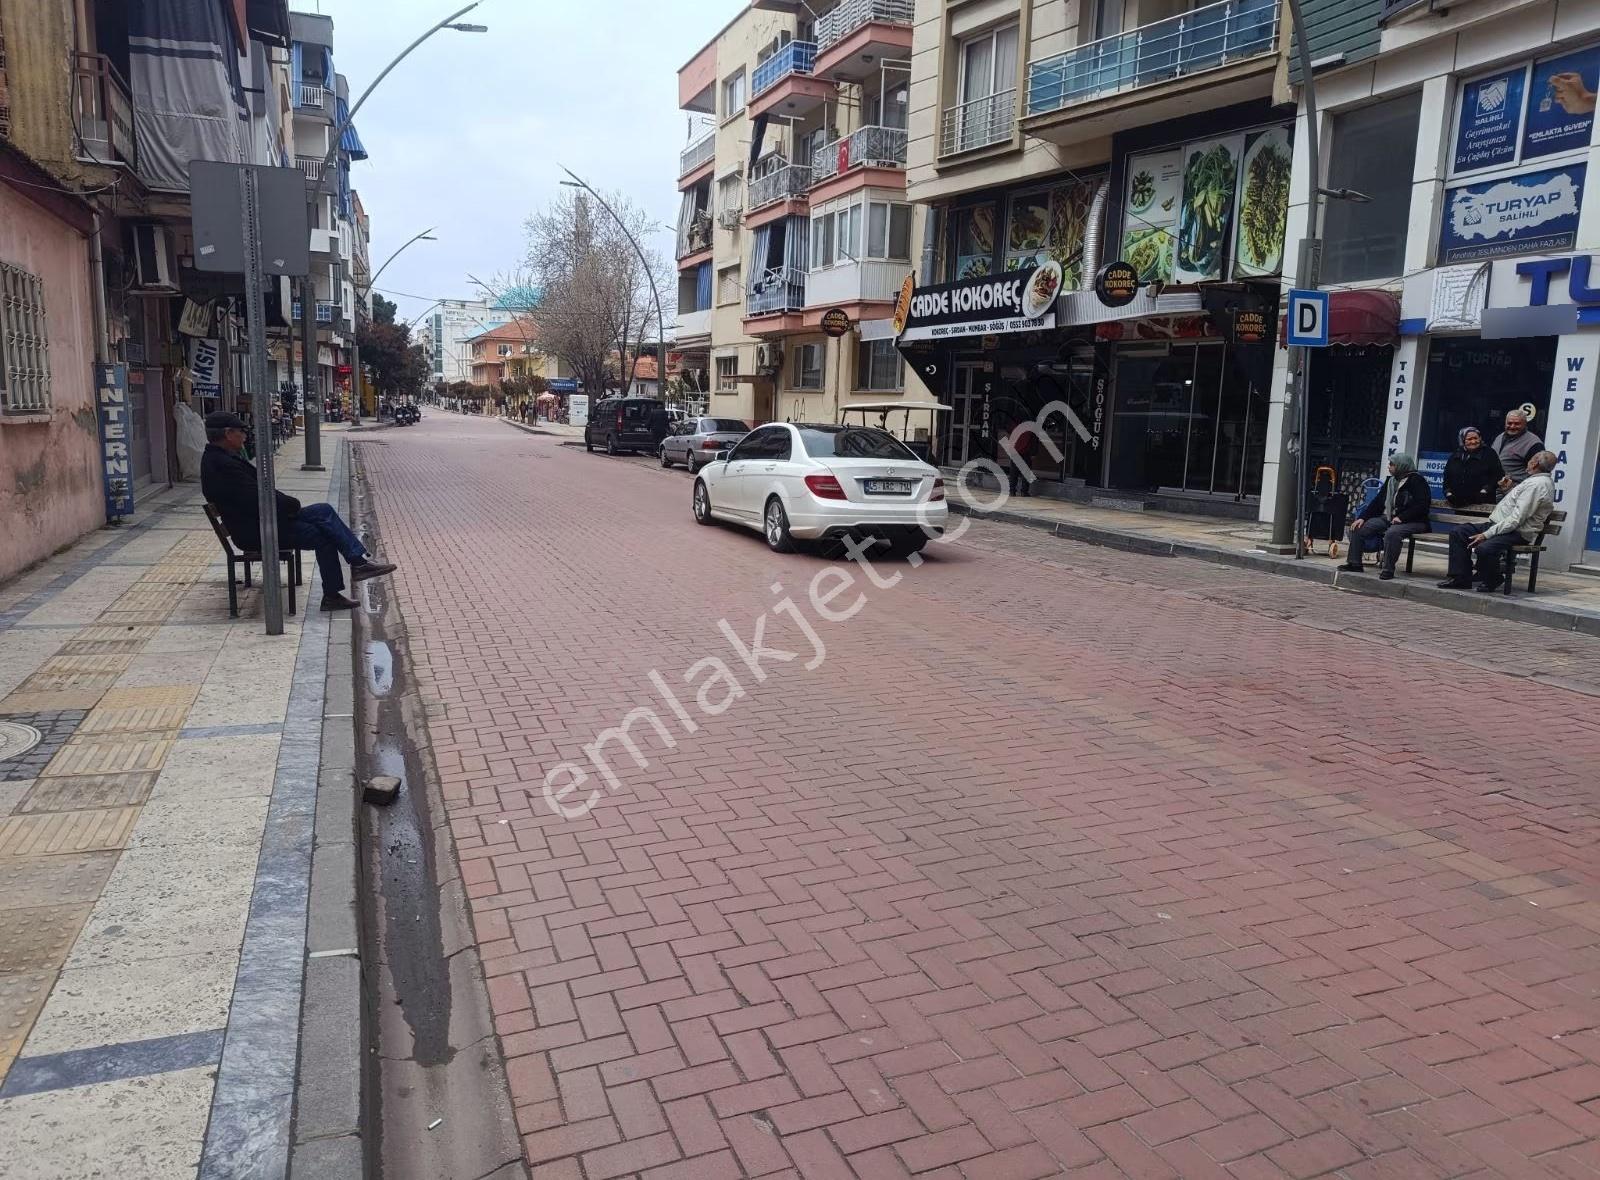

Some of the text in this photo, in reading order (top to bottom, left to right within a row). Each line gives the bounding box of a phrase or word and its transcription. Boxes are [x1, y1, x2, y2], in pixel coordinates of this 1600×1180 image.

[1465, 120, 1511, 139] Gayrimenkul
[1485, 191, 1561, 215] TURYAP
[1499, 208, 1539, 223] SALİHLİ
[1104, 279, 1135, 289] KOKOREÇ
[1108, 269, 1131, 280] CADDE
[910, 279, 1022, 318] CADDE KOKOREÇ
[1235, 323, 1266, 333] KOKOREÇ
[1239, 313, 1264, 323] CADDE
[1298, 303, 1317, 333] D
[1394, 361, 1407, 410] TAPU
[1563, 357, 1584, 411] WEB
[1554, 431, 1570, 503] TAPU
